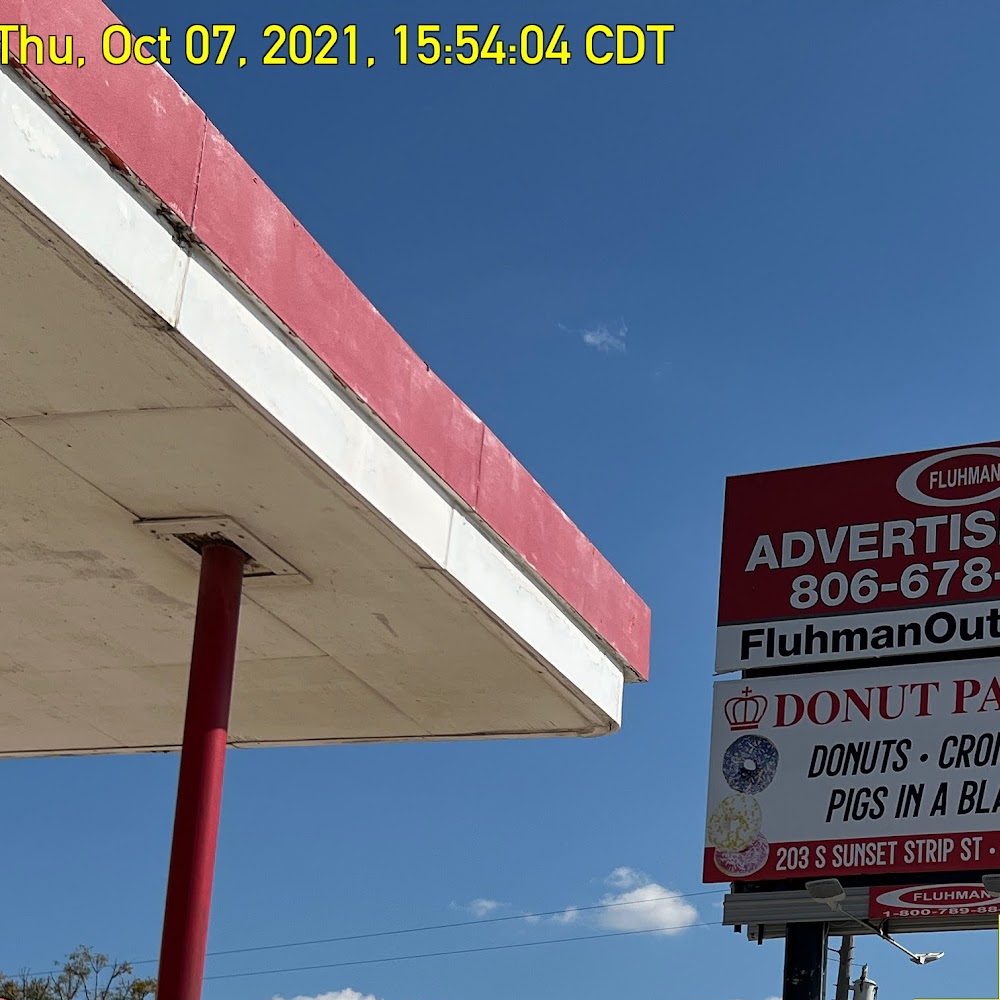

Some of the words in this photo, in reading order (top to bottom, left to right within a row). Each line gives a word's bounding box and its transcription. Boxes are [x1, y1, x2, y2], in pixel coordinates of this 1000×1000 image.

[929, 463, 1000, 491] FLUHMAN
[772, 681, 940, 728] DONUT
[808, 738, 910, 779] DONUTS
[825, 786, 886, 823] PIGS
[895, 784, 923, 819] IN
[929, 782, 950, 817] A
[775, 845, 810, 871] 203
[815, 846, 827, 869] S
[832, 840, 898, 867] SUNSET
[903, 838, 954, 864] STRIP
[960, 836, 983, 861] ST
